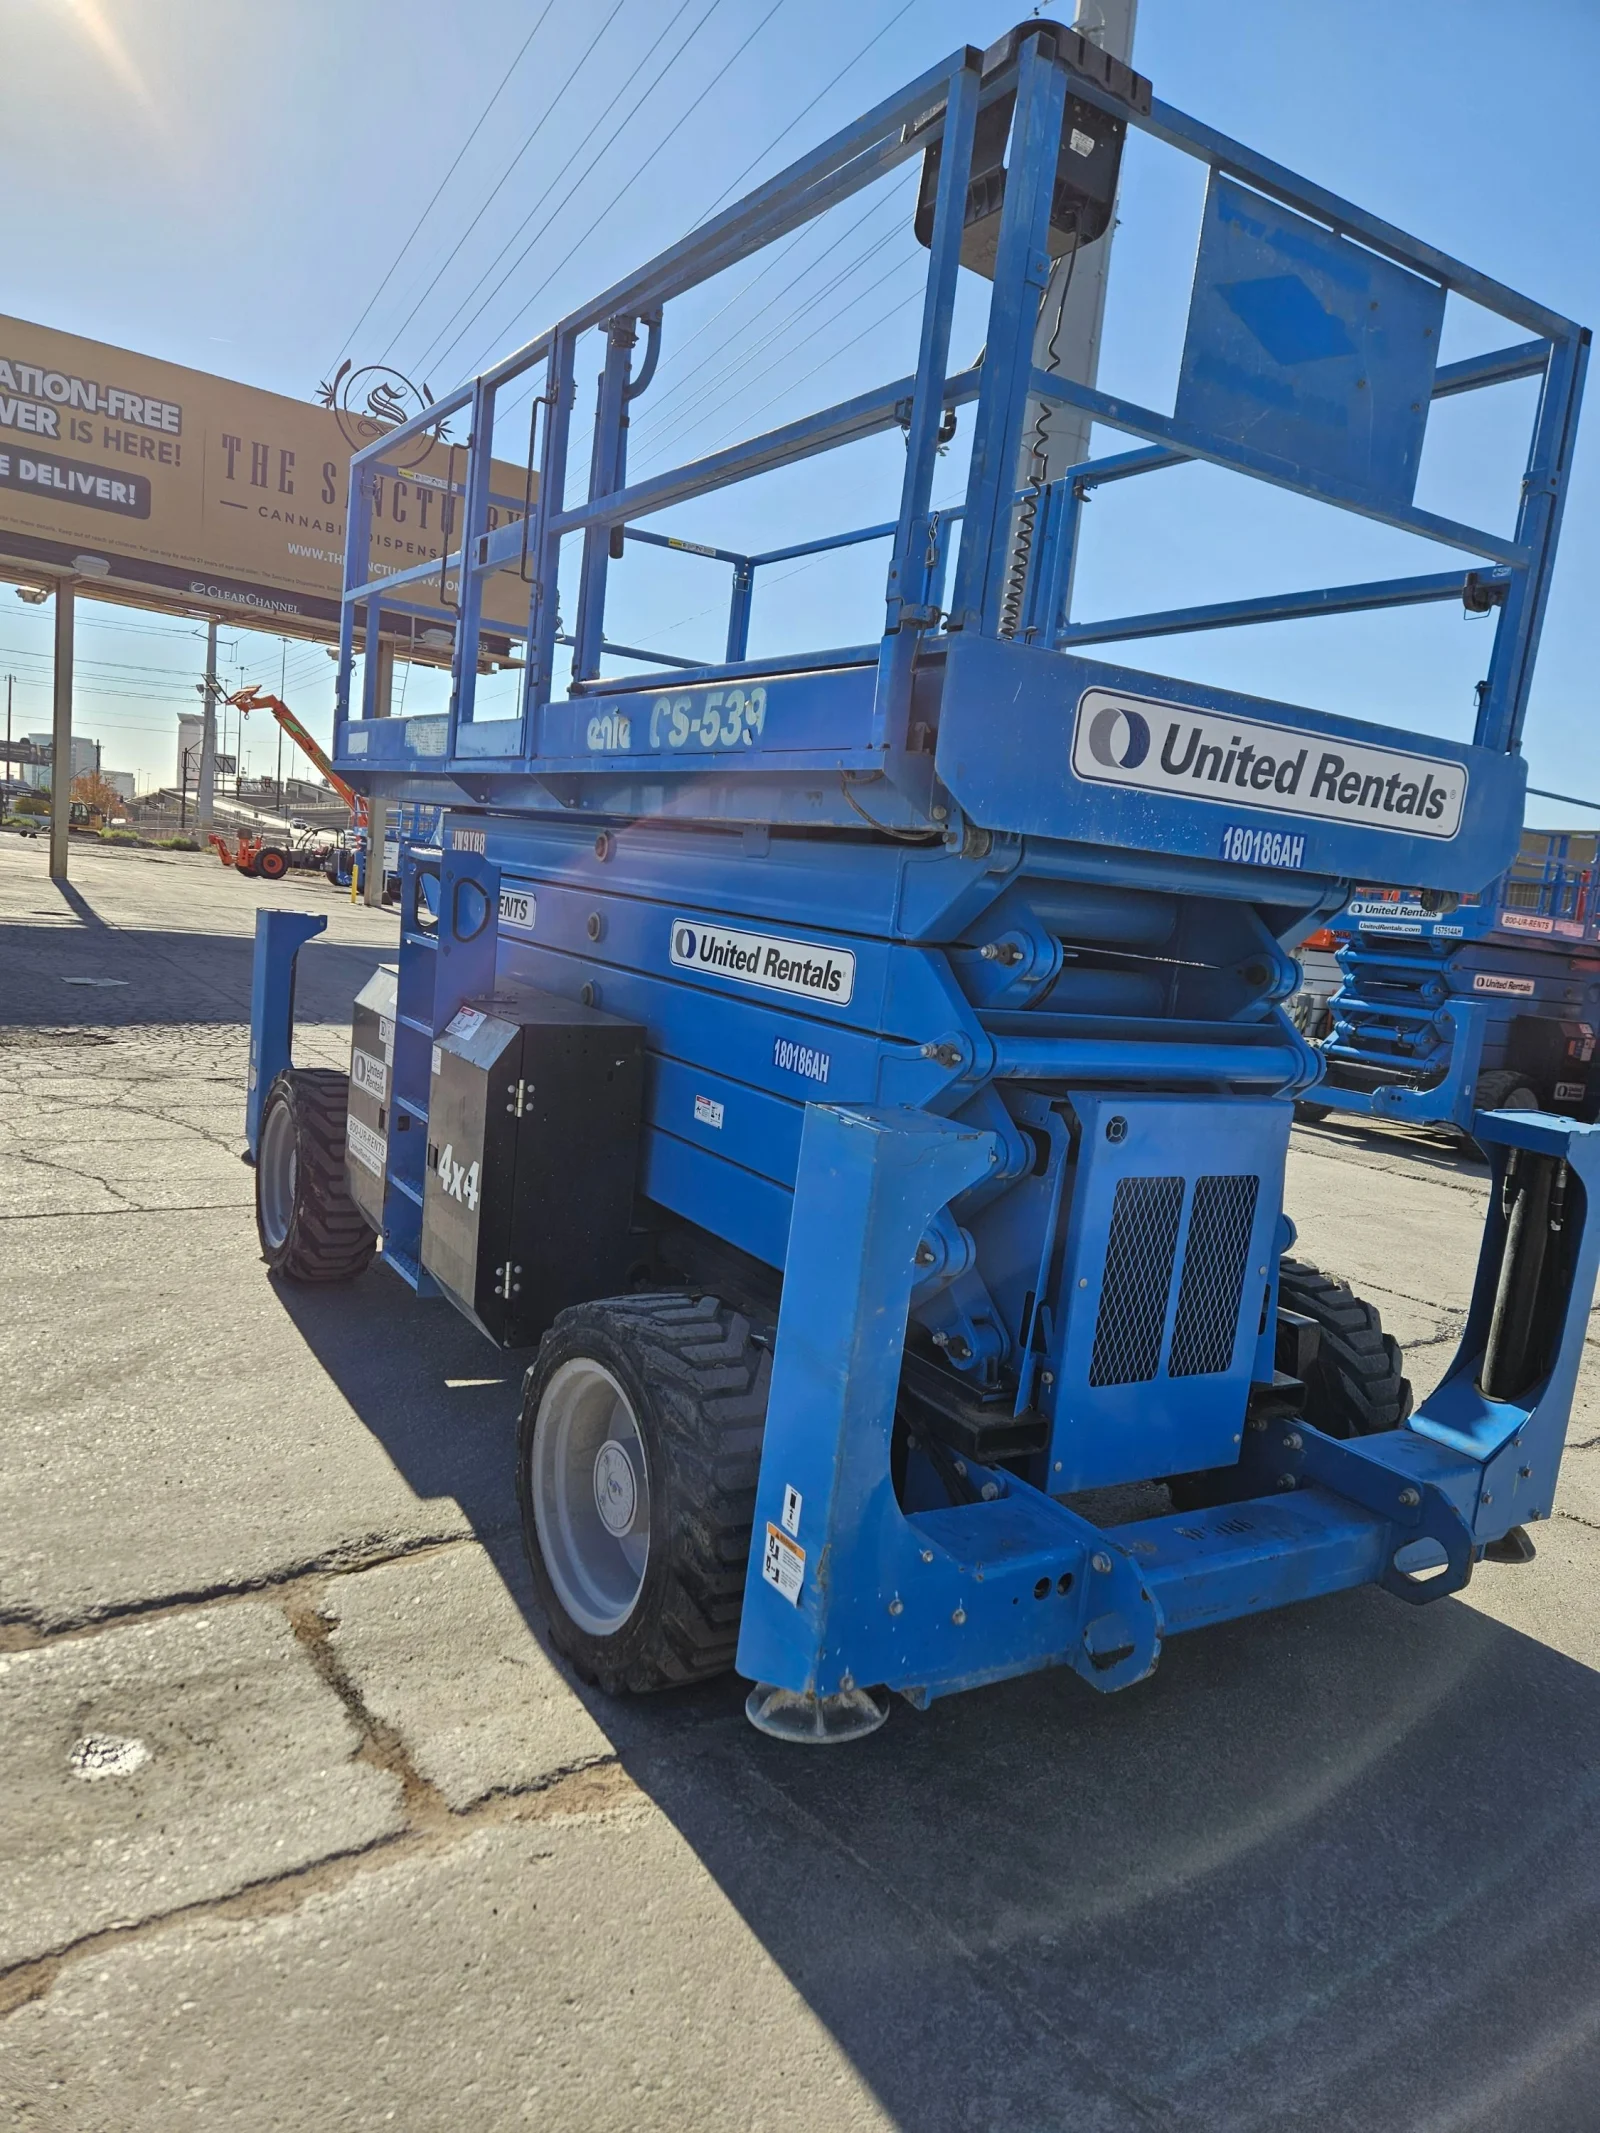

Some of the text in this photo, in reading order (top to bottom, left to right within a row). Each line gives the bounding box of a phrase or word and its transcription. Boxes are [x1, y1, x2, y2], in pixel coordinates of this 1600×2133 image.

[70, 417, 94, 444] IS
[103, 426, 182, 468] HERE!
[19, 458, 136, 506] DELIVER!
[221, 432, 296, 495] THE
[258, 506, 343, 536] CANNABI
[1160, 723, 1447, 820] United Rentals
[1223, 826, 1305, 868] 180186AH
[1360, 922, 1421, 933] UnitedRentals.com
[1364, 904, 1438, 918] United Rentals
[699, 934, 842, 992] United Rentals
[1485, 978, 1532, 992] United Rentals
[366, 1060, 385, 1080] United
[774, 1038, 830, 1084] 180186AH
[365, 1074, 384, 1095] Rentals
[349, 1119, 386, 1157] 800-UR-RENTS
